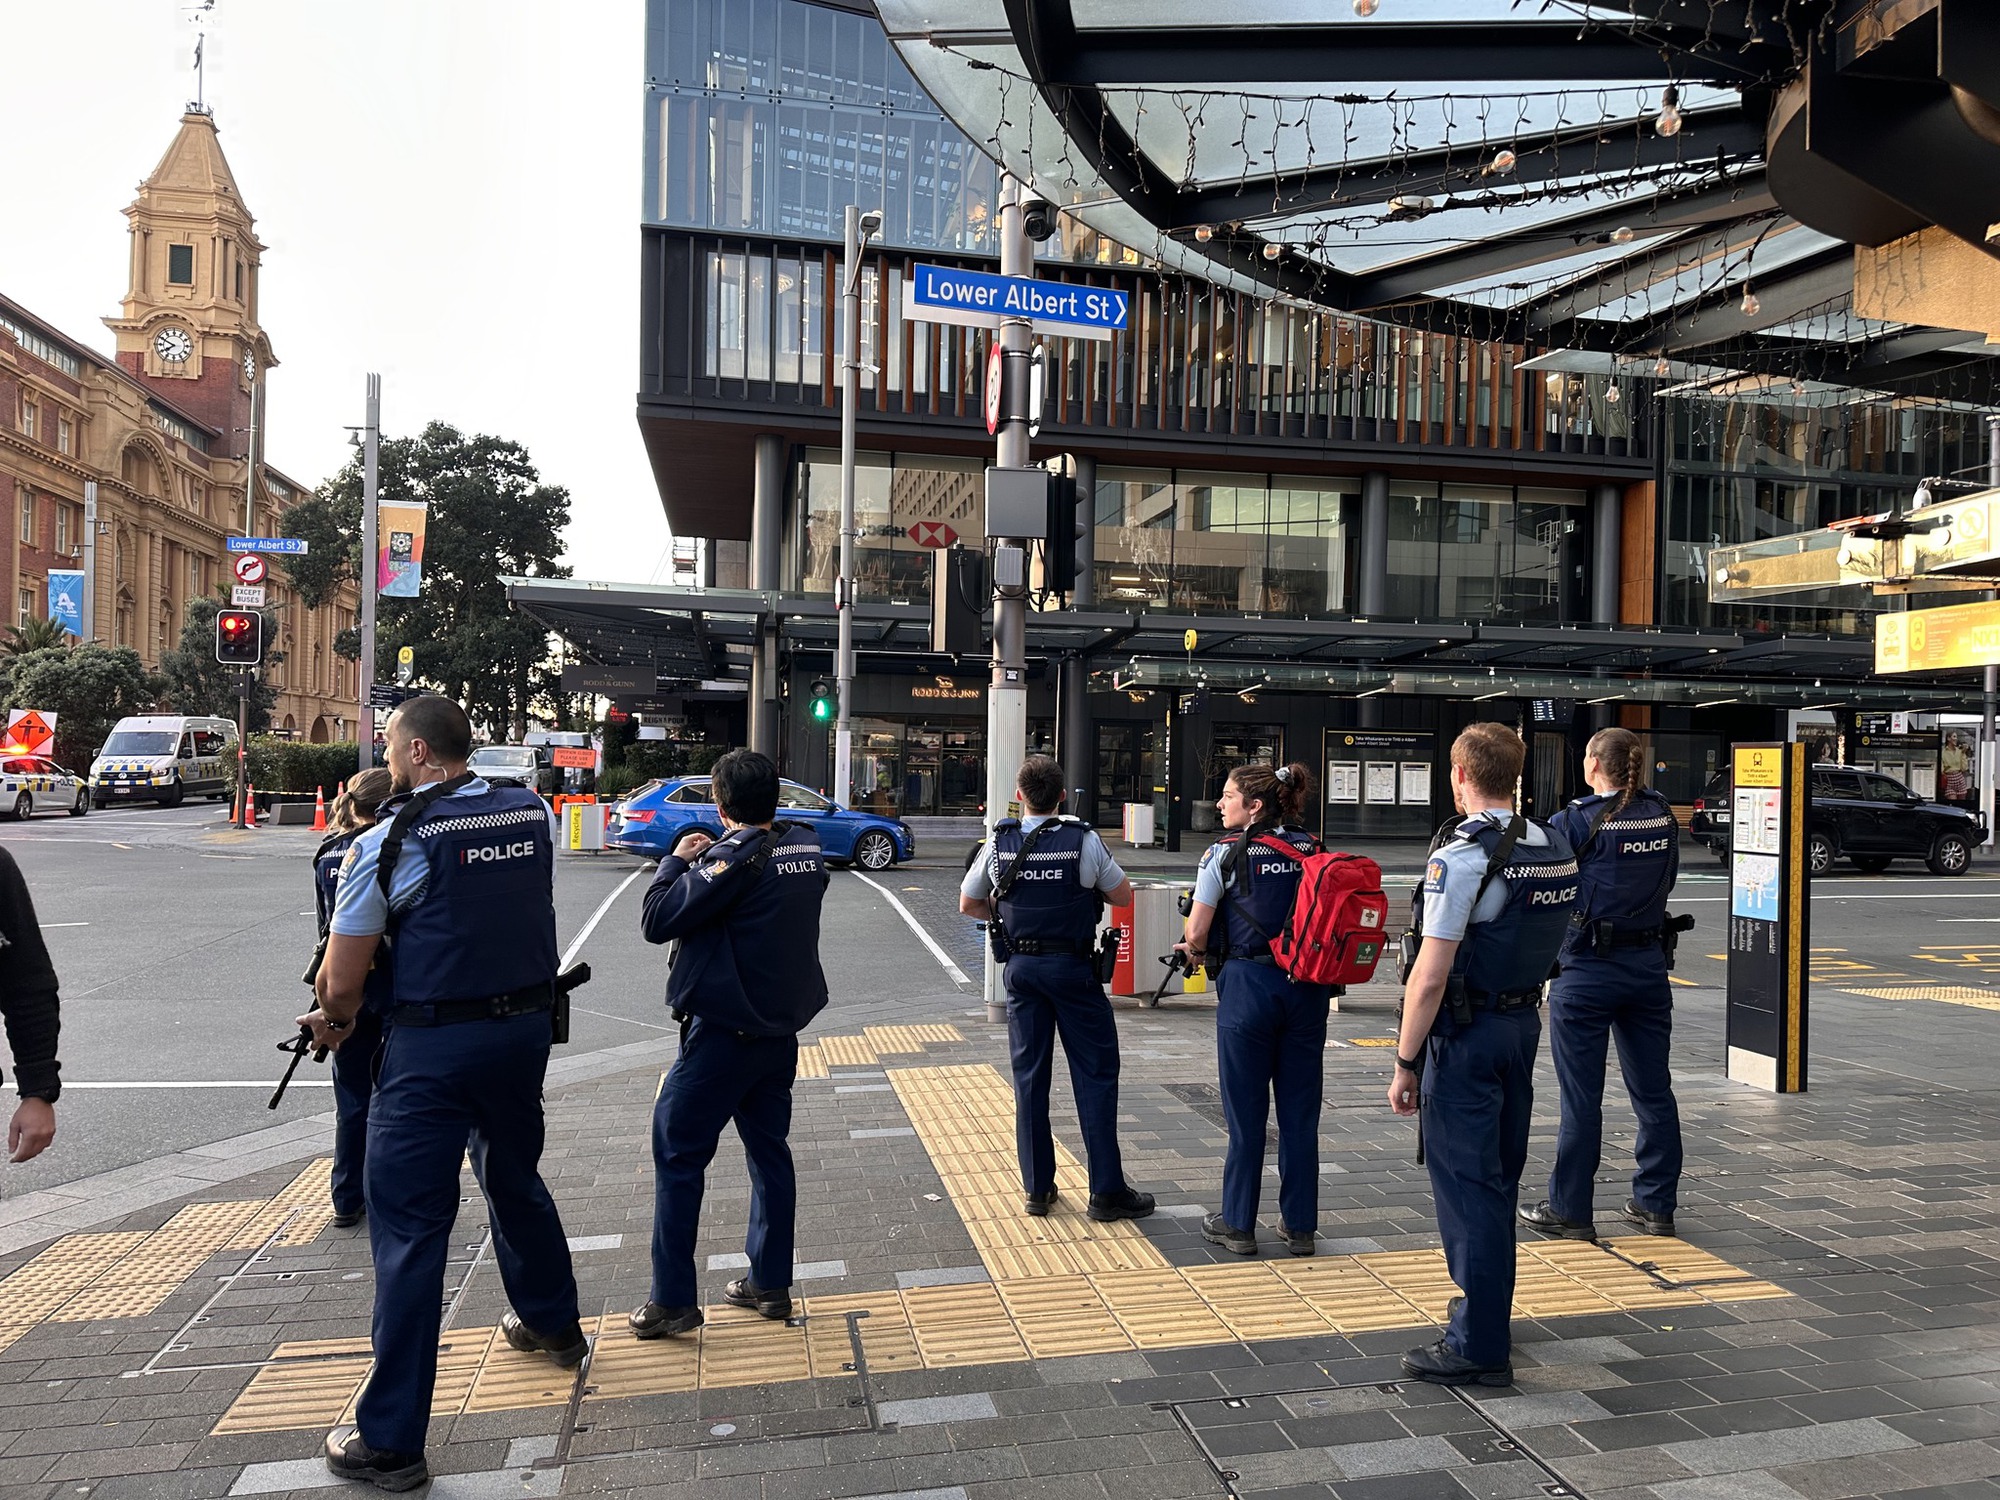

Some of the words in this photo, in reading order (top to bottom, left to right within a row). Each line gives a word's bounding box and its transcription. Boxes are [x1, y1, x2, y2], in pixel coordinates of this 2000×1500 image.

[927, 273, 998, 306] Lower
[1004, 284, 1077, 317] Albert
[1085, 294, 1110, 320] St
[231, 540, 256, 549] Lower
[258, 540, 284, 550] Albert
[286, 541, 296, 550] St
[235, 588, 261, 596] EXCEPT
[236, 595, 260, 604] BUSES
[912, 688, 939, 698] RODD
[940, 689, 949, 698] &
[949, 689, 980, 699] GUNN
[572, 812, 581, 844] Recycling
[467, 840, 534, 864] POLICE
[1623, 838, 1669, 854] POLICE
[776, 860, 817, 876] POLICE
[1016, 869, 1063, 880] POLICE
[1261, 862, 1302, 875] POLIC
[1532, 885, 1578, 905] POLICE
[1117, 922, 1130, 963] Litter
